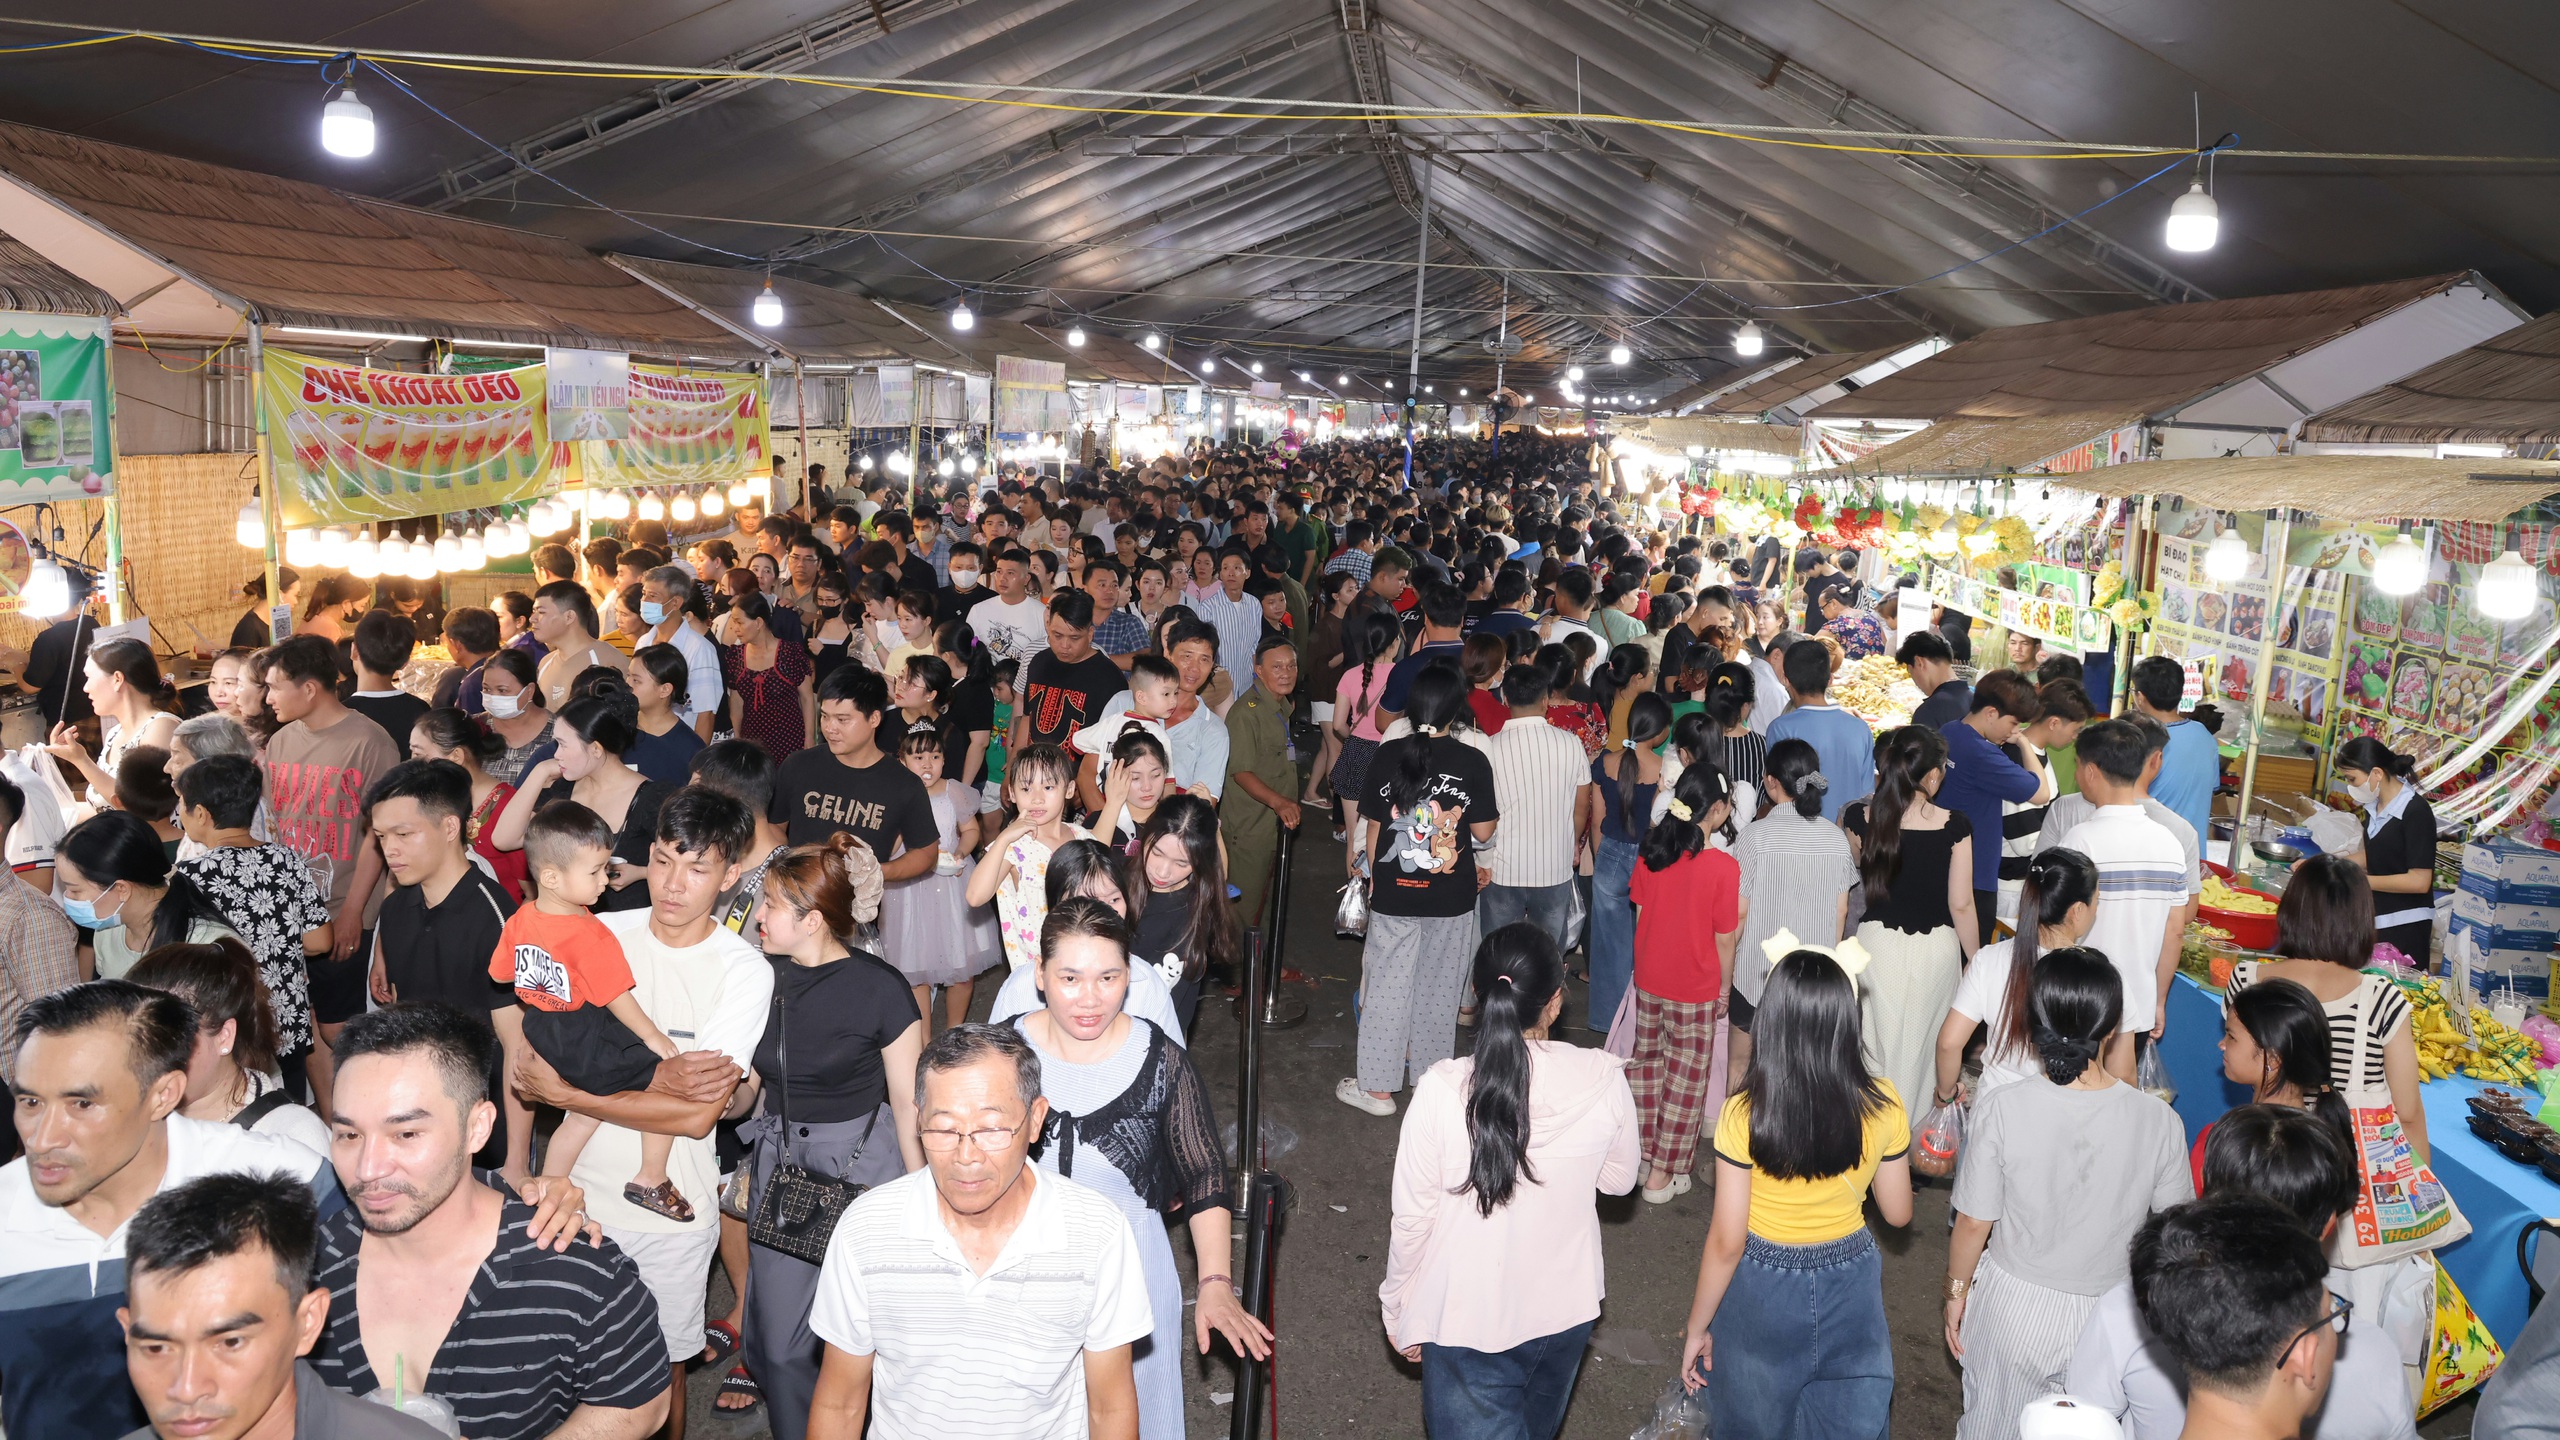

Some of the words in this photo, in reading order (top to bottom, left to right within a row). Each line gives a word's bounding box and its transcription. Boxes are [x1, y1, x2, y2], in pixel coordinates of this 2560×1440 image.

[367, 373, 464, 406] KHOAI
[553, 380, 572, 407] LÂM
[609, 386, 626, 408] NGA
[2164, 545, 2172, 558] BÍ
[2172, 549, 2188, 564] ĐAO
[803, 791, 886, 830] CELINE
[2525, 872, 2560, 884] AQUAFINA
[2516, 918, 2550, 930] AQUAFINA
[2355, 1193, 2371, 1216] 30
[2358, 1222, 2376, 1244] 29
